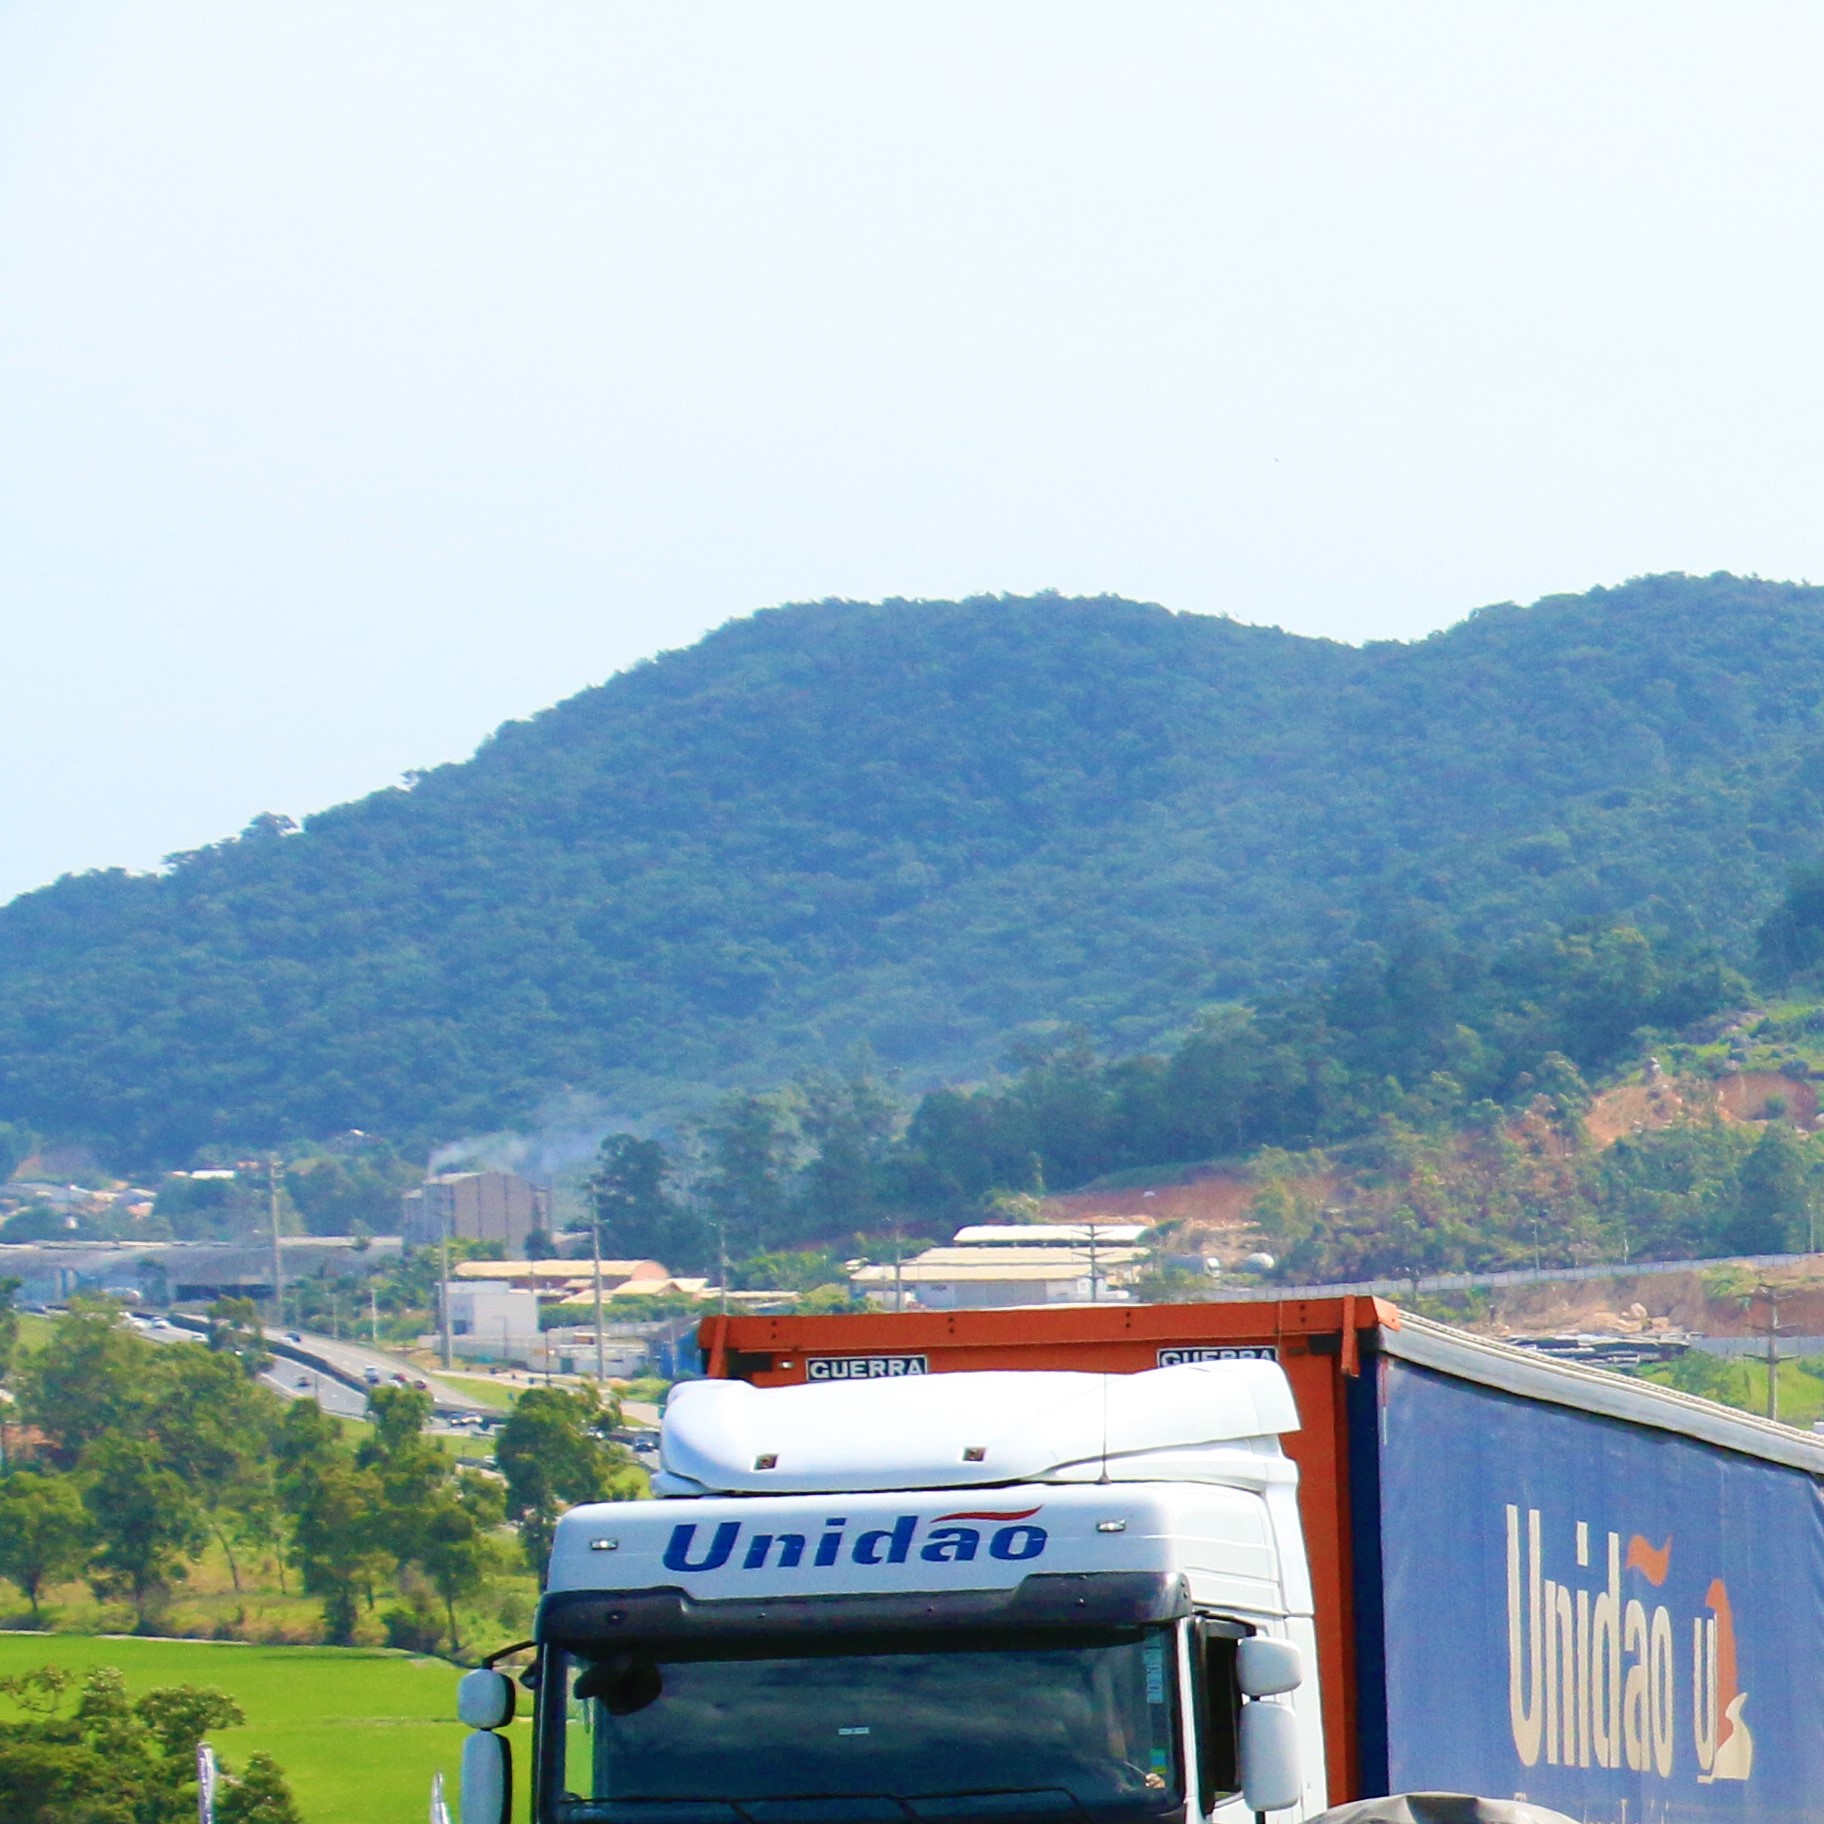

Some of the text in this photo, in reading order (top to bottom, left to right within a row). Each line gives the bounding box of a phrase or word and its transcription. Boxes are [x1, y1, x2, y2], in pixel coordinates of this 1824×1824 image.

[809, 1359, 923, 1379] GUERRA
[662, 1503, 1050, 1572] Unidão
[1506, 1503, 1674, 1778] Unidão
